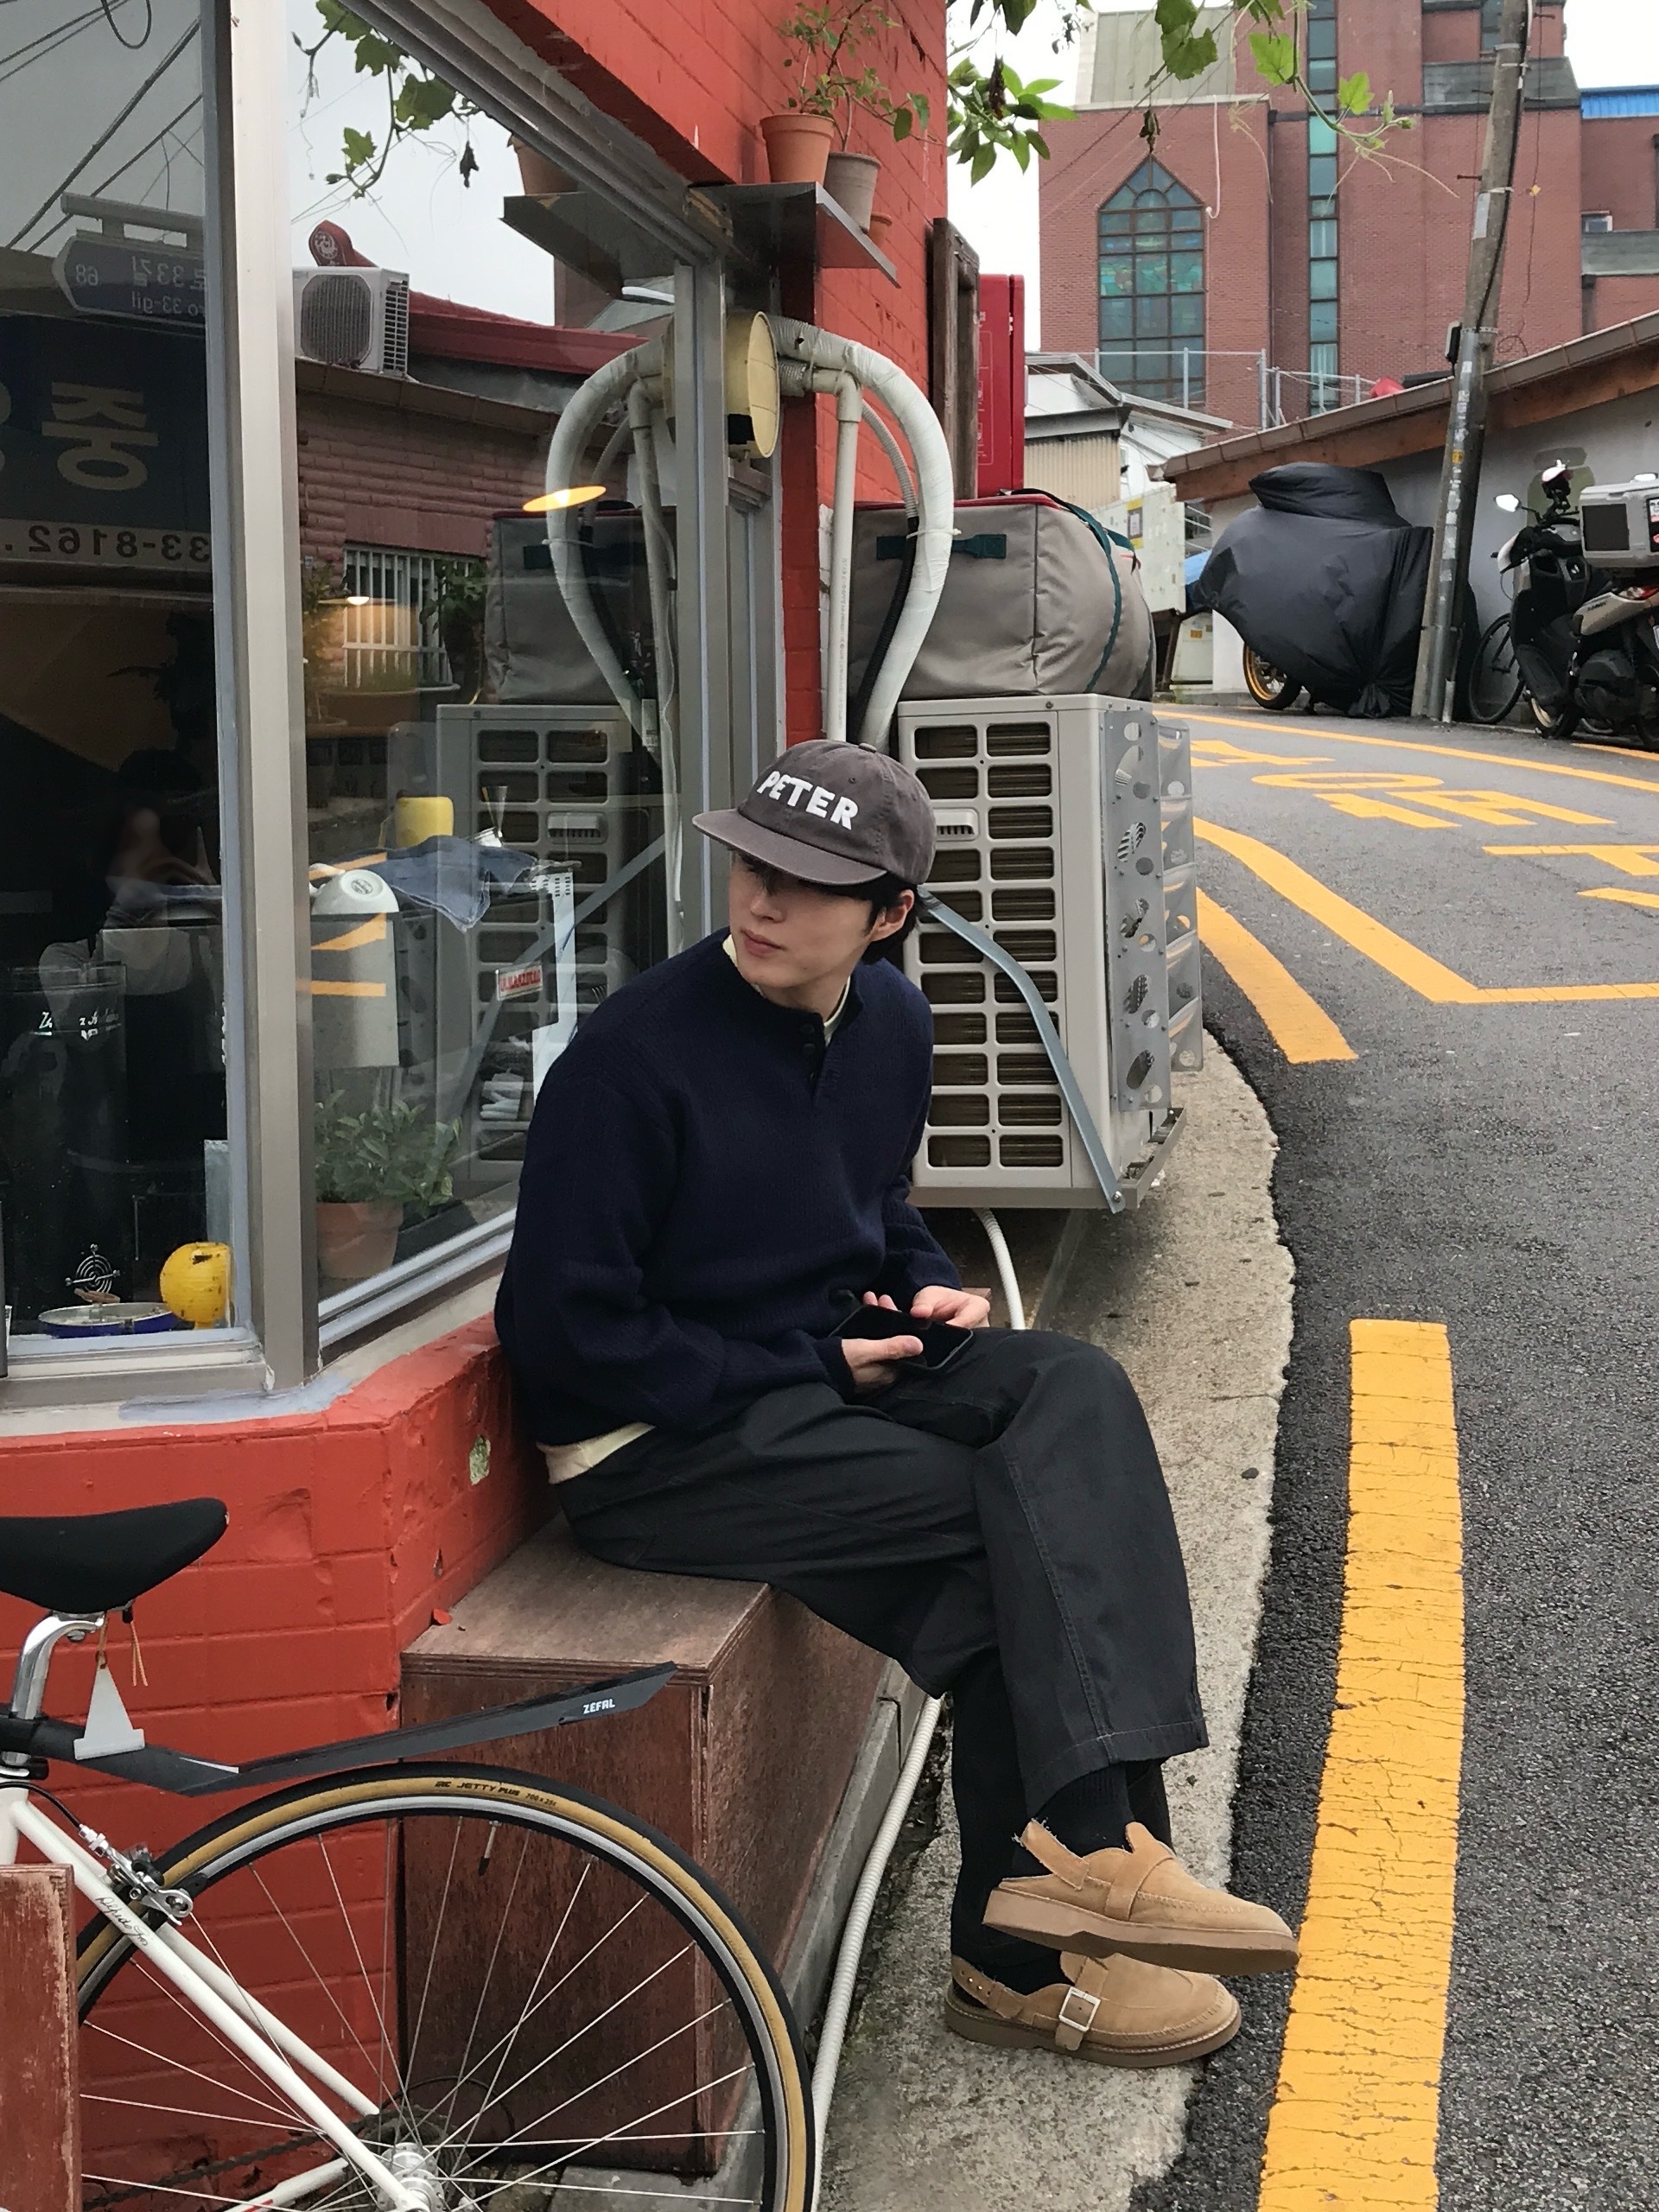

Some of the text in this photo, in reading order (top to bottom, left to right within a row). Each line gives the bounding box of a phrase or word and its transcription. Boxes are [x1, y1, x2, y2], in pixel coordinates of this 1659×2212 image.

[757, 771, 859, 830] PETER
[582, 1698, 616, 1715] ZEFAL
[456, 1782, 497, 1792] JETTY
[498, 1786, 521, 1796] PLUS
